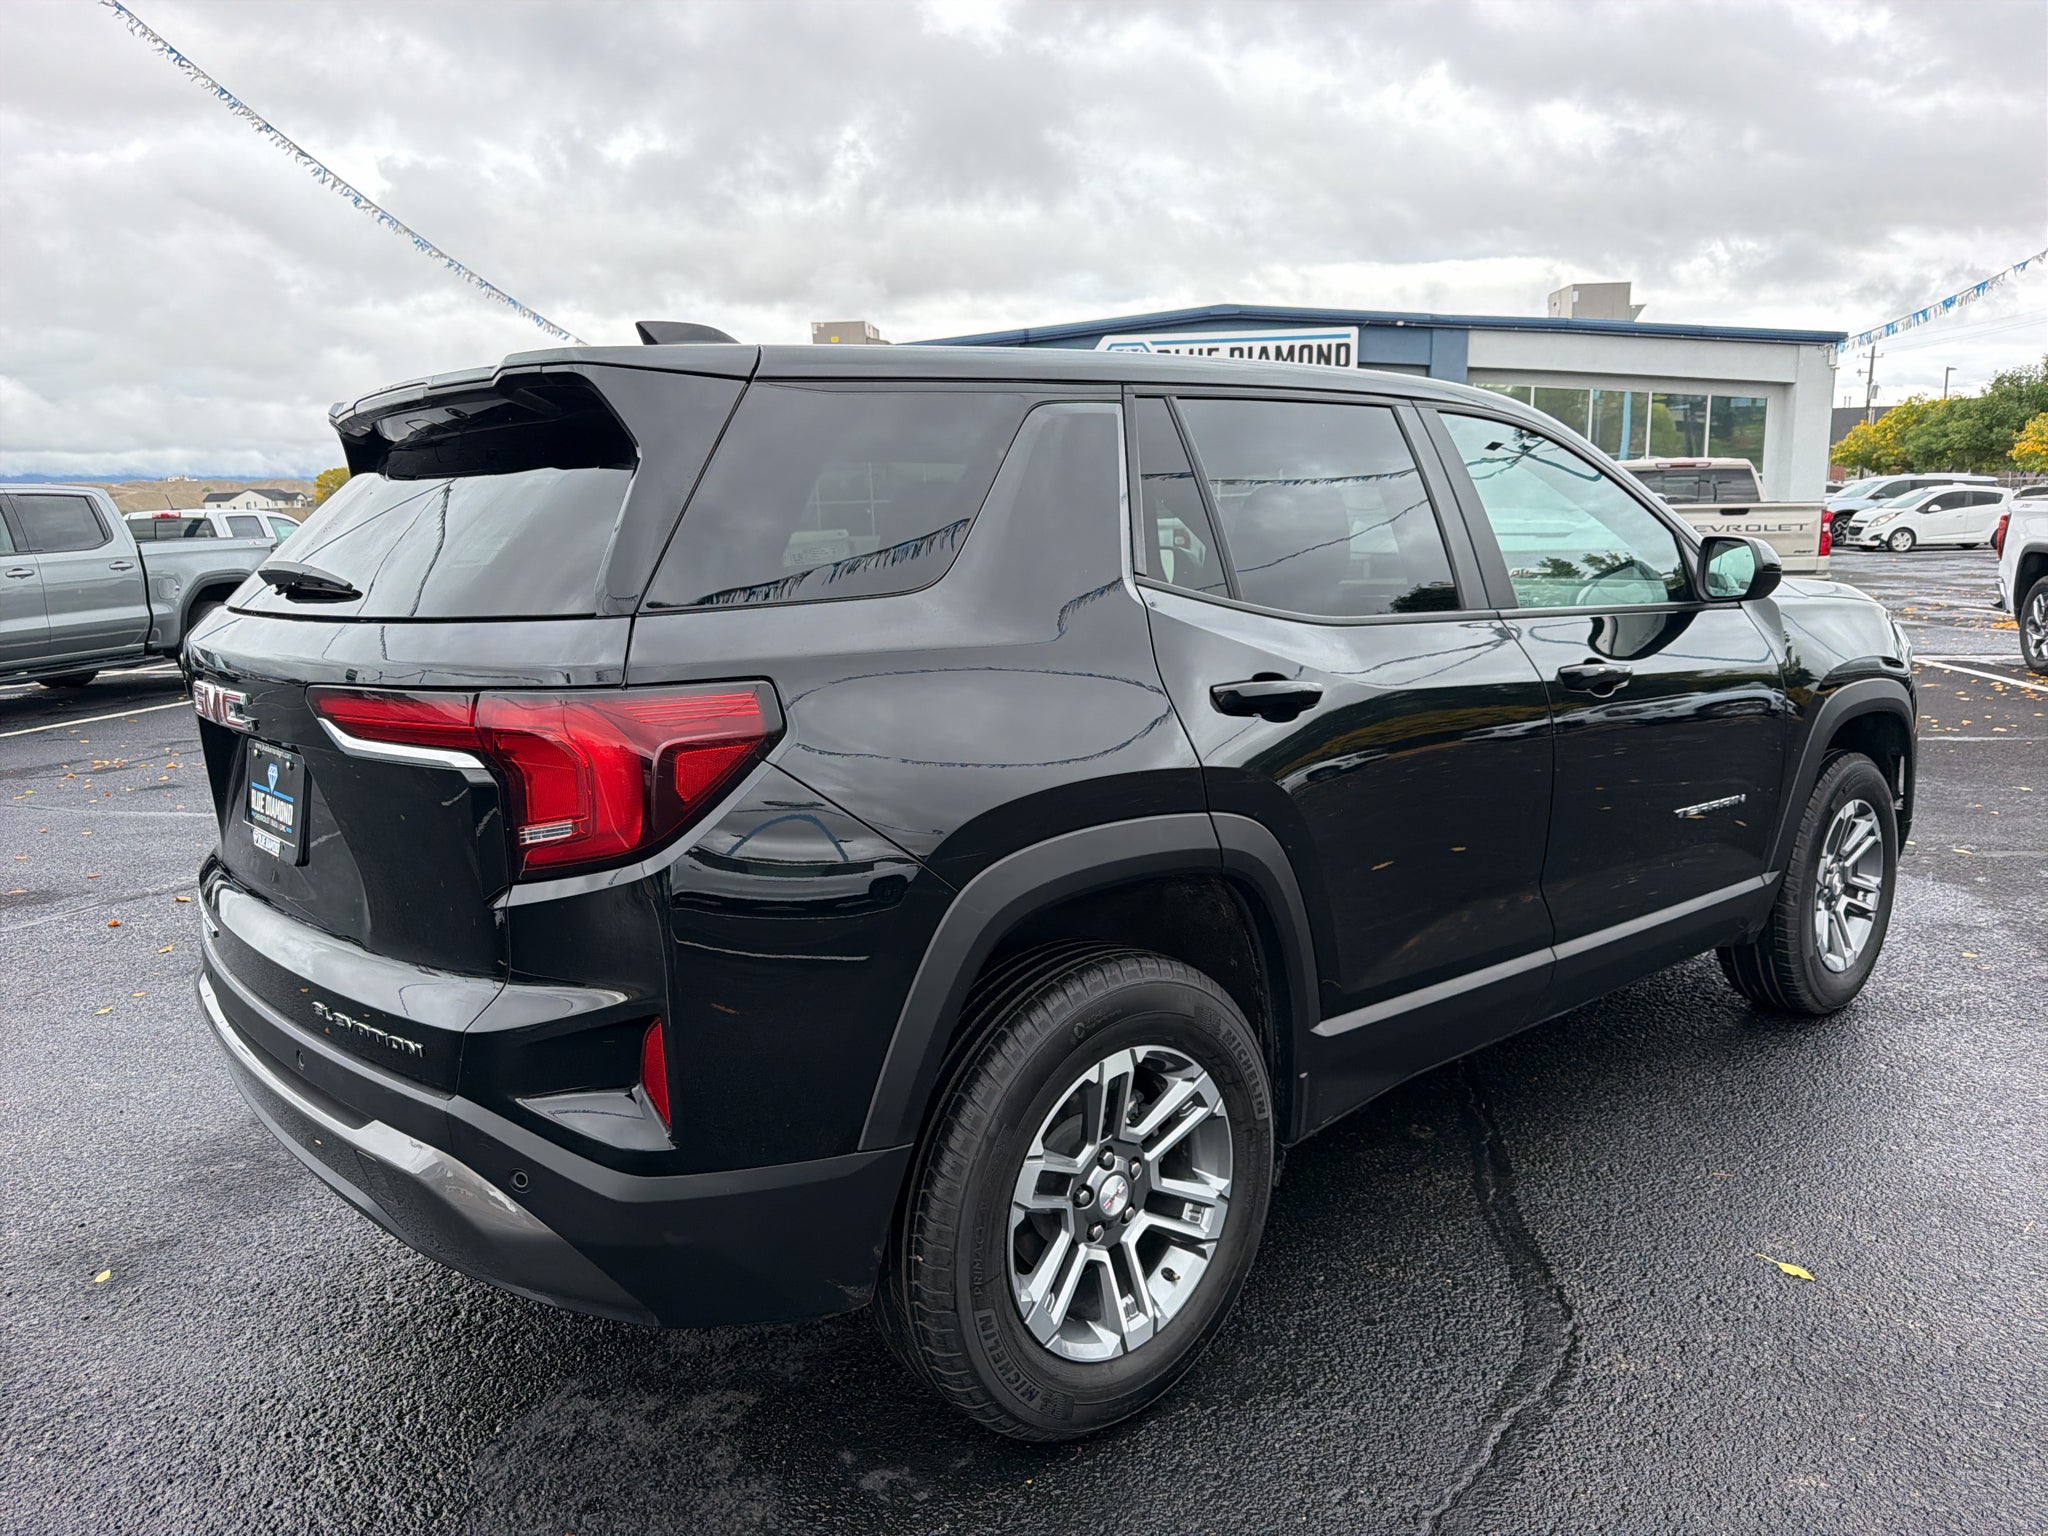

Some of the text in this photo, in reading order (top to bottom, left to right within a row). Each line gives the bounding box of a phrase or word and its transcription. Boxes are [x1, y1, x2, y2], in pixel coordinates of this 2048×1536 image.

[193, 679, 261, 732] GMC
[265, 794, 294, 826] DIAMOND
[1221, 1027, 1267, 1115] MICHELIN
[978, 1314, 1041, 1402] MICHELIN
